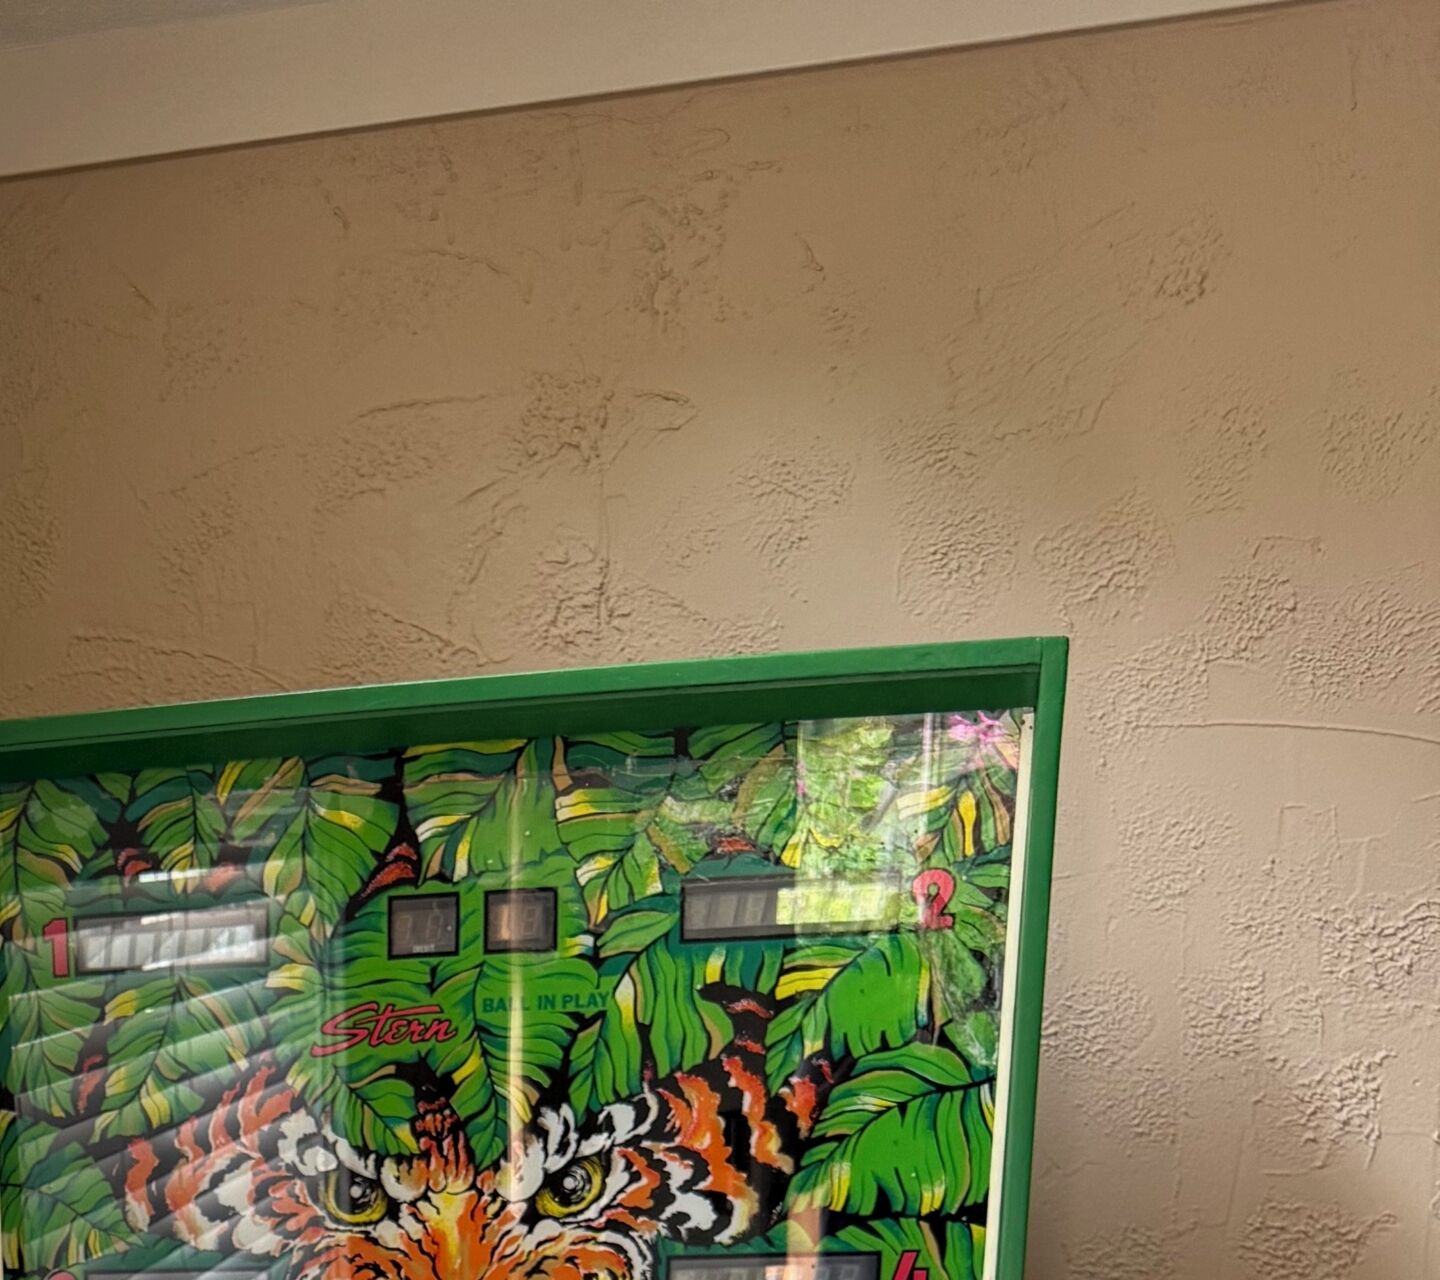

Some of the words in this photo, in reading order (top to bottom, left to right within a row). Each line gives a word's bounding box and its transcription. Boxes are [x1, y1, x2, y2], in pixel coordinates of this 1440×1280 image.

[912, 867, 957, 930] 2
[43, 917, 71, 978] 1
[311, 1002, 455, 1057] Stern
[538, 994, 556, 1010] IN
[561, 991, 609, 1009] PLAY
